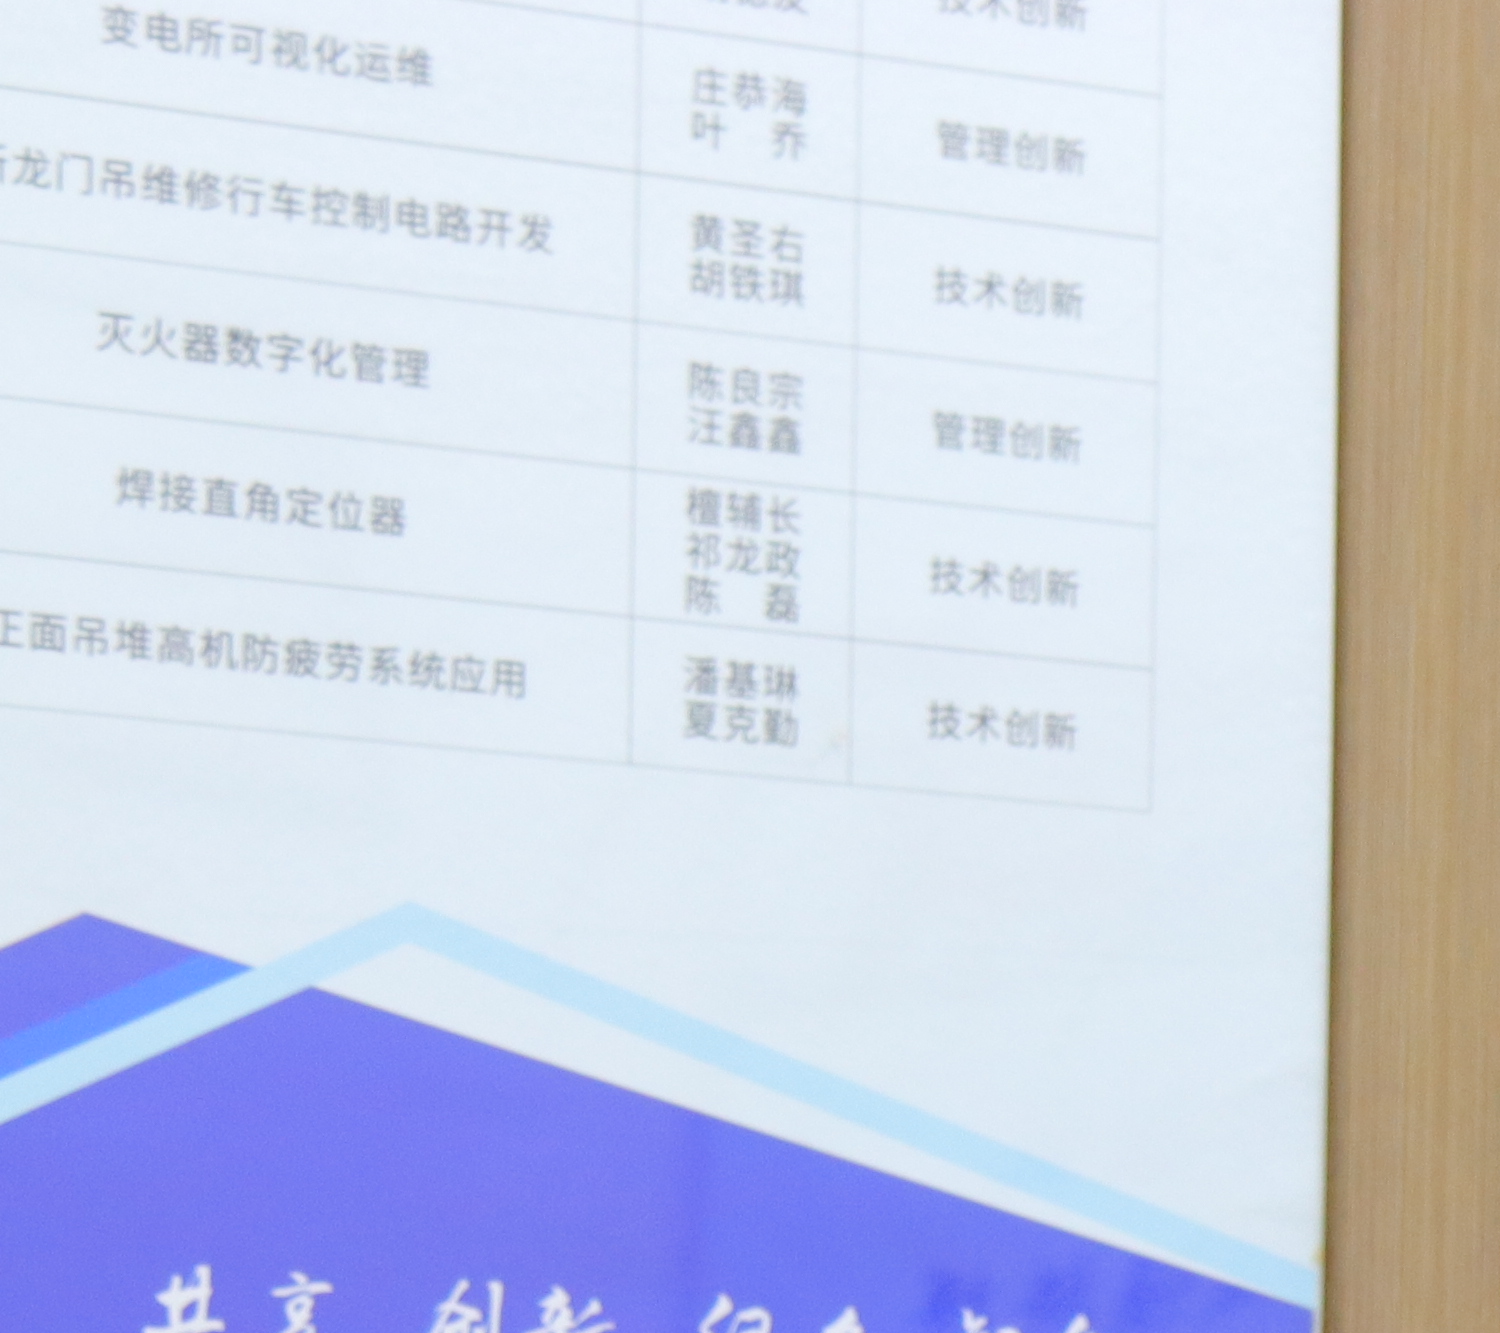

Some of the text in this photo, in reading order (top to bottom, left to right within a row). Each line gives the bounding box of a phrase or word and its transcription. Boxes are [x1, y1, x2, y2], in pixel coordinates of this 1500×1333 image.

[102, 5, 431, 86] 变电所可视化运维
[937, 120, 1085, 172] 管理创新
[935, 267, 1083, 317] 技术创新
[98, 311, 428, 388] 灭火器数字化管理
[933, 410, 1080, 460] 管理创新
[117, 468, 405, 536] 焊接直角定位器
[930, 558, 1078, 605] 技术创新
[928, 702, 1076, 748] 技术创新
